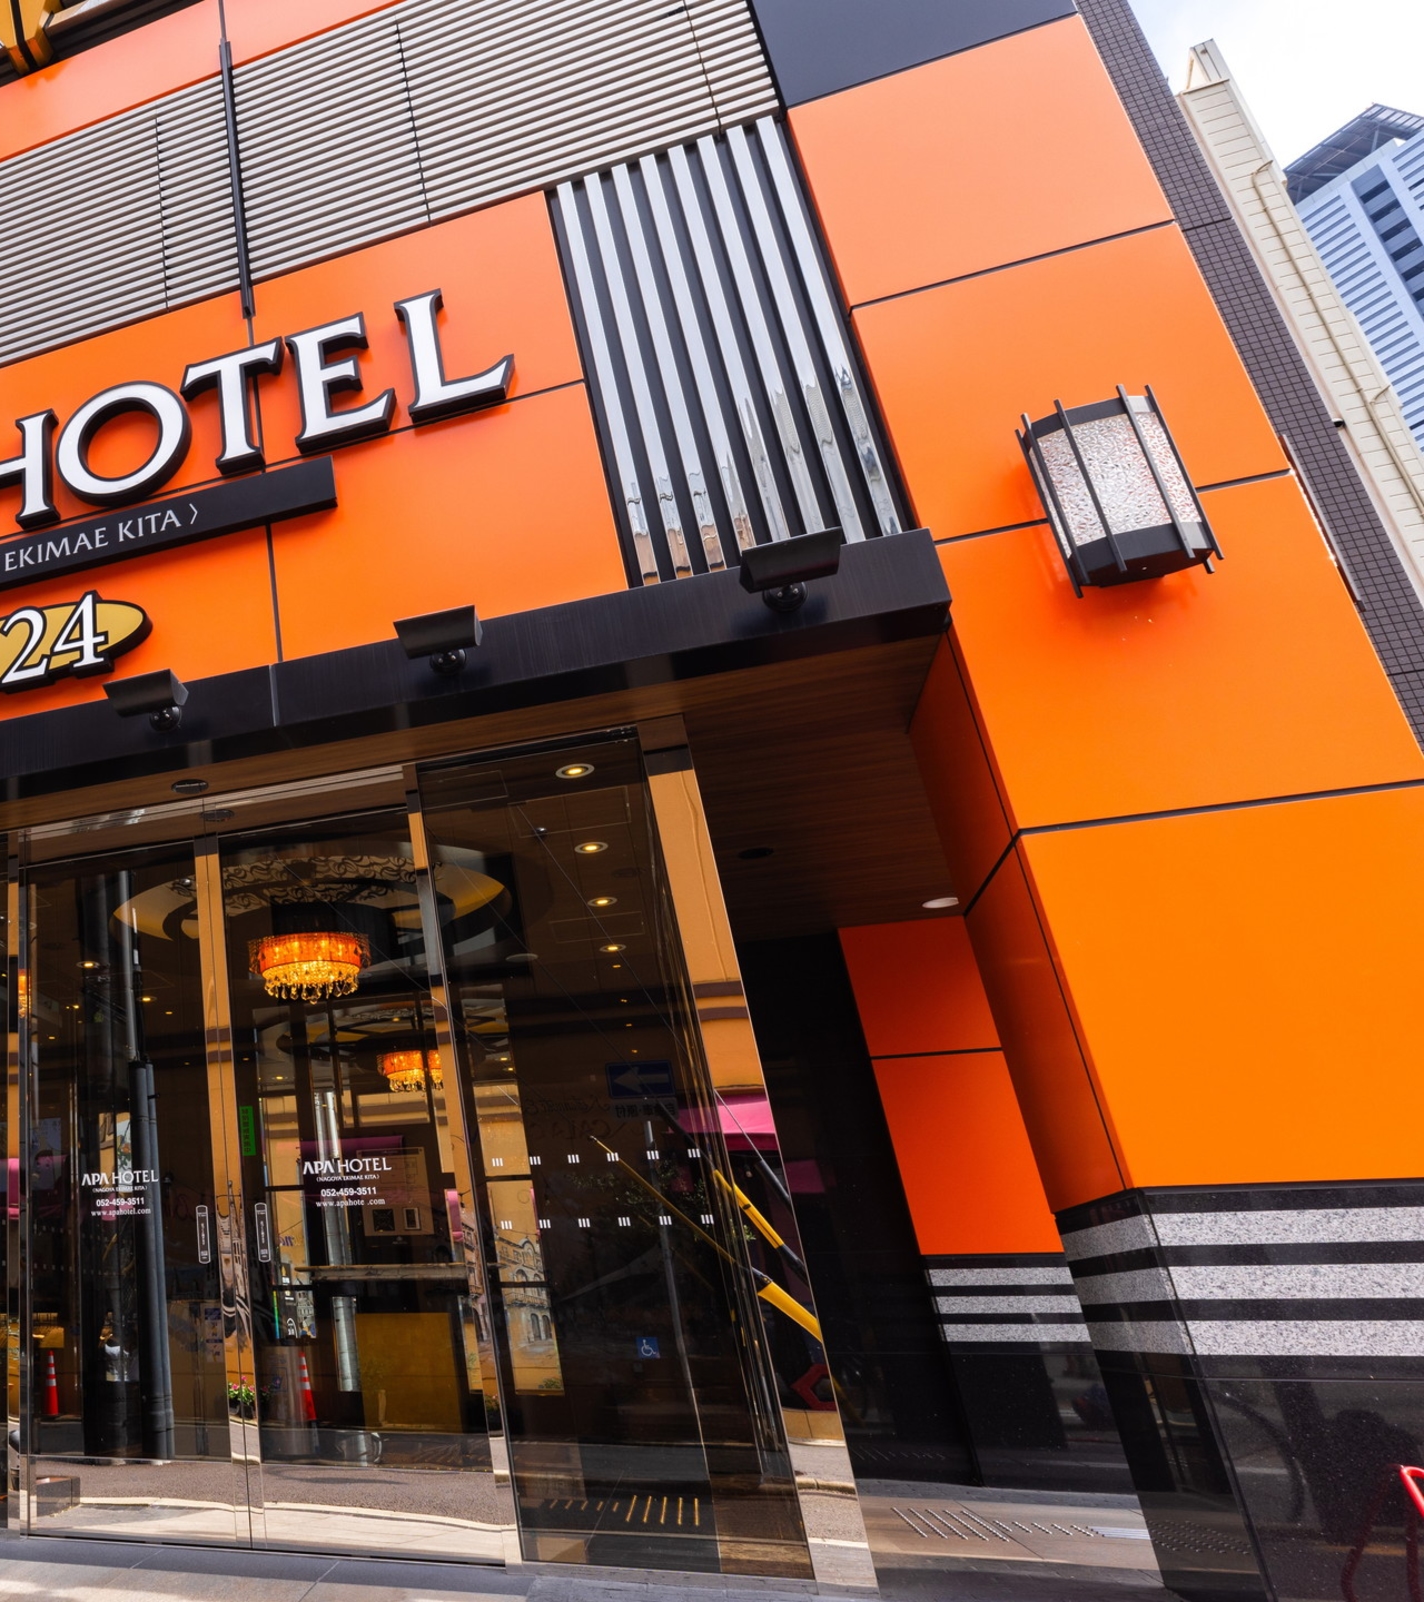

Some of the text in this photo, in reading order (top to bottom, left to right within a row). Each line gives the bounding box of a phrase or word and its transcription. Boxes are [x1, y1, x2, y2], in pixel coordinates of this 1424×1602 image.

[3, 526, 110, 573] EKIMAE
[303, 1157, 392, 1175] APA HOTEL
[81, 1170, 159, 1186] APA HOTEL
[321, 1187, 377, 1197] 052-459-3511
[96, 1197, 145, 1207] 052-459-3511
[316, 1198, 386, 1208] www.apahote.com
[90, 1207, 151, 1217] www.apahotel.com
